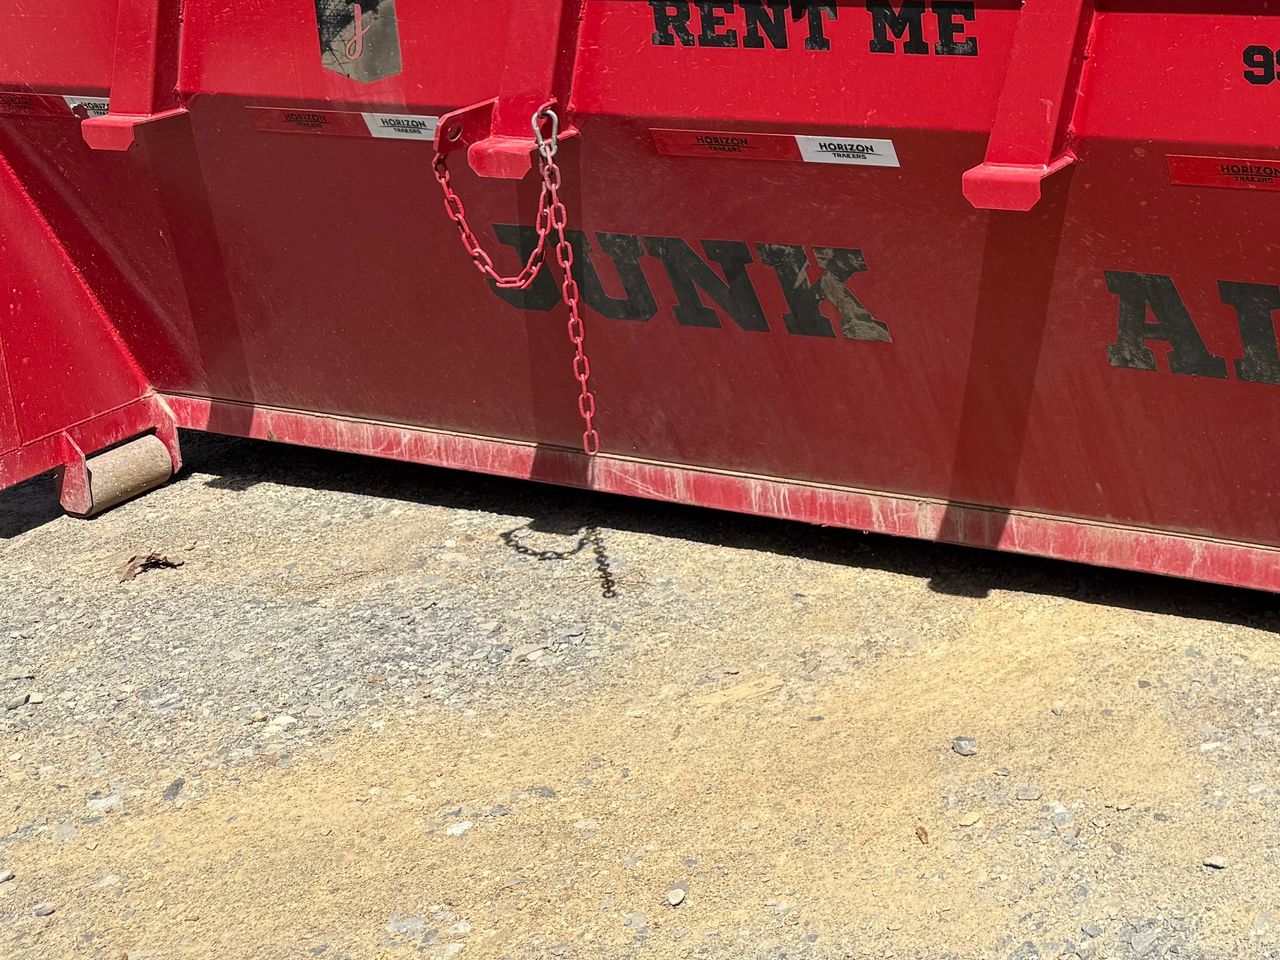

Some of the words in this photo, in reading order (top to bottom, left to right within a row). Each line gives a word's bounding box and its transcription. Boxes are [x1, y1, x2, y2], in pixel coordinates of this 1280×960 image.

[866, 0, 979, 56] ME
[380, 117, 427, 128] HORIZON
[393, 127, 422, 135] TRAILERS
[696, 135, 749, 147] HORIZON
[818, 142, 875, 154] HORIZON
[832, 152, 868, 160] TRAILERS
[1235, 175, 1275, 184] TRAILERS
[485, 223, 893, 343] JUNK
